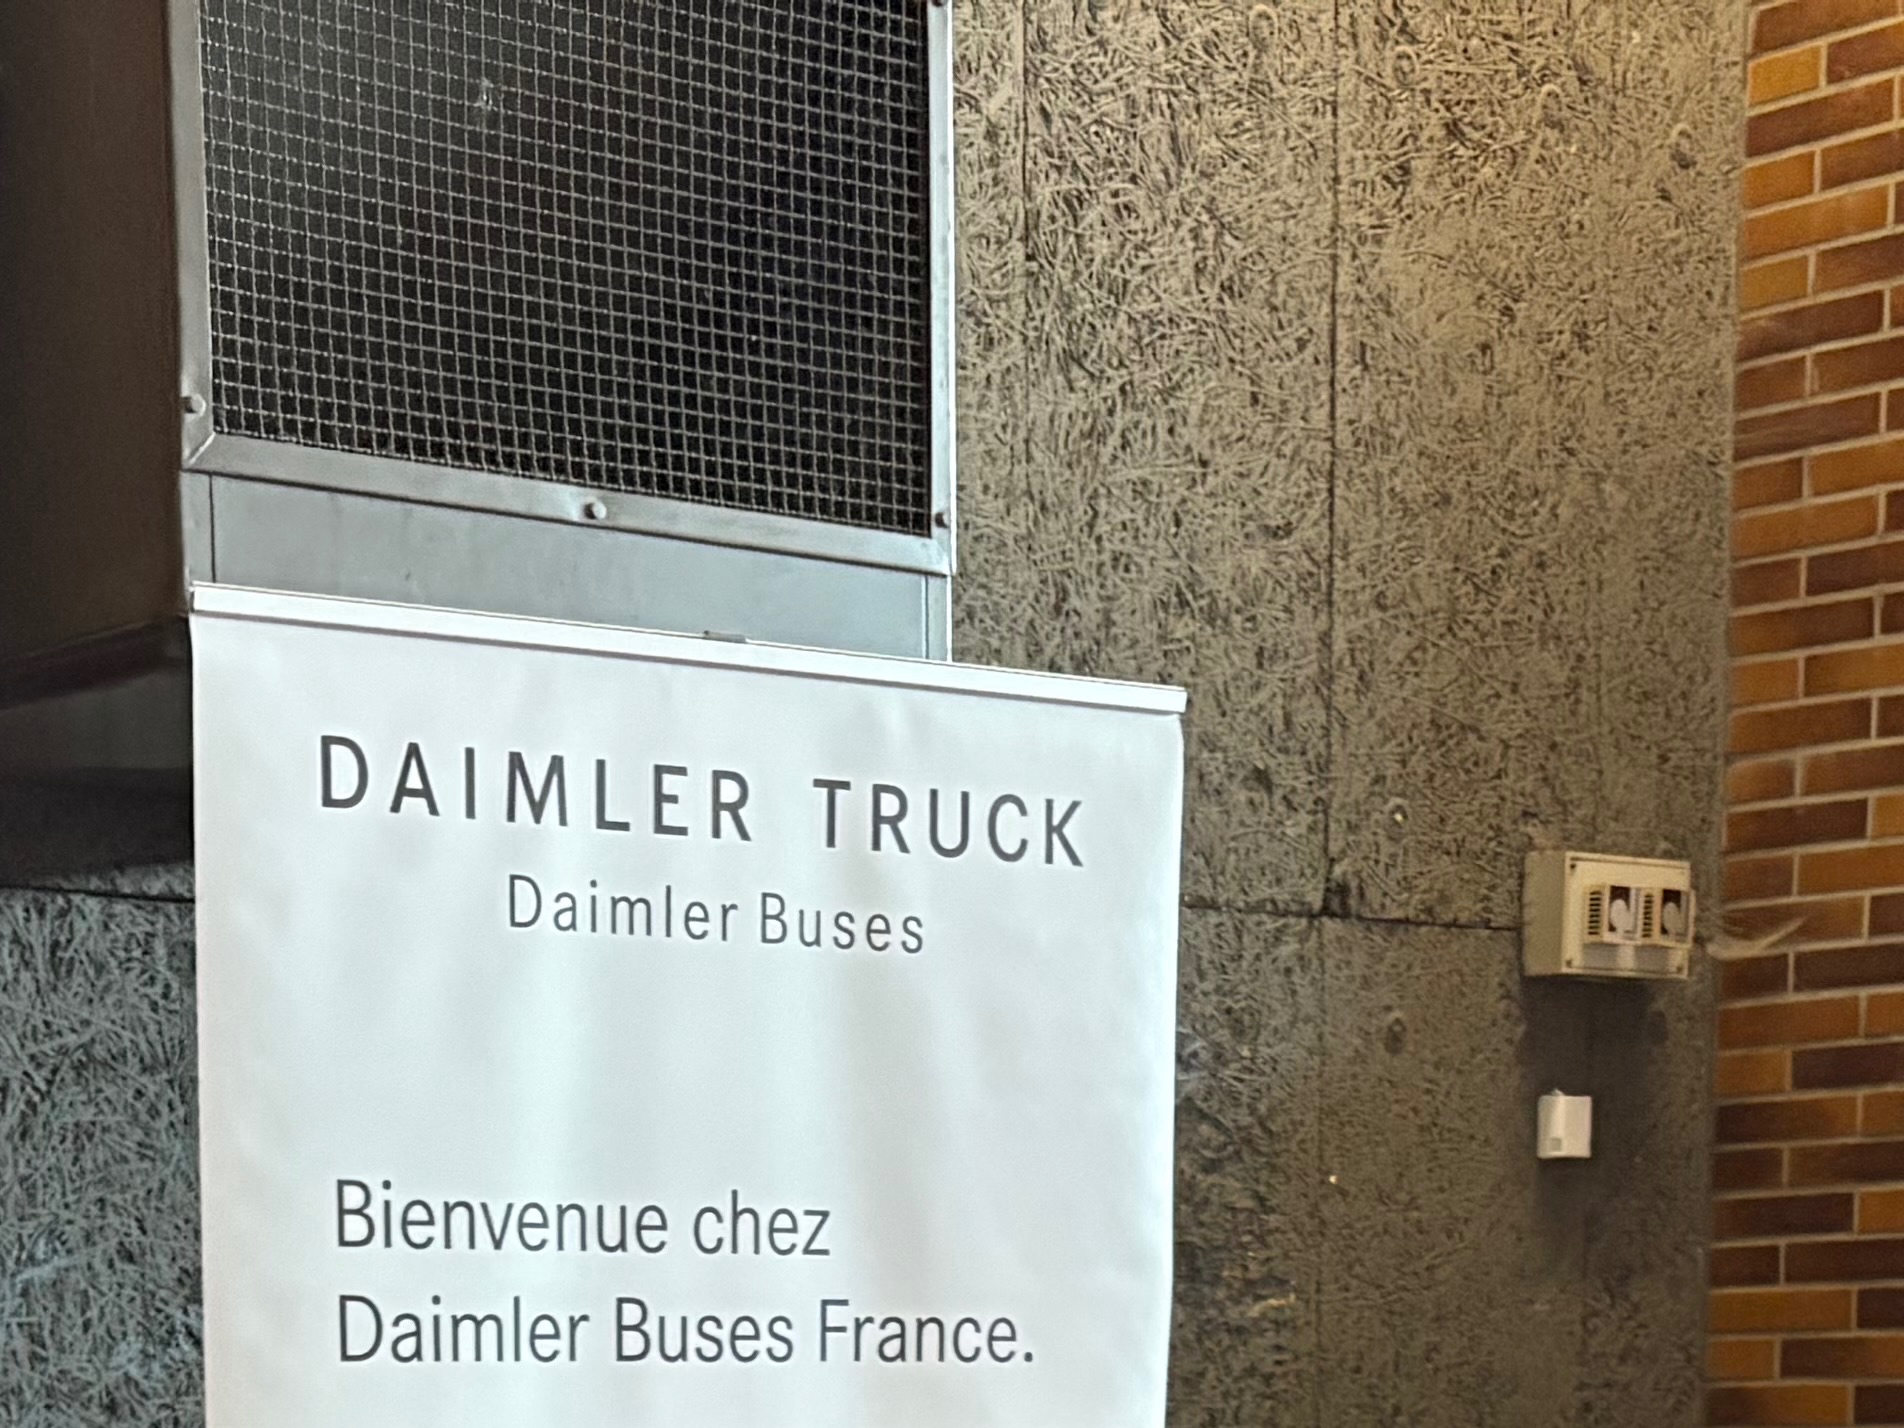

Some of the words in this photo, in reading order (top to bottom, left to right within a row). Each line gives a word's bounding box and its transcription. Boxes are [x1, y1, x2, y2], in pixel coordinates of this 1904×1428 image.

[319, 734, 752, 844] DAIMLER
[813, 777, 1084, 868] TRUCK
[509, 873, 739, 943] Daimler
[760, 893, 925, 955] Buses
[335, 1178, 669, 1256] Bienvenue
[693, 1190, 832, 1258] chez
[338, 1294, 592, 1364] Daimler
[615, 1296, 793, 1364] Buses
[819, 1298, 1035, 1364] France.
